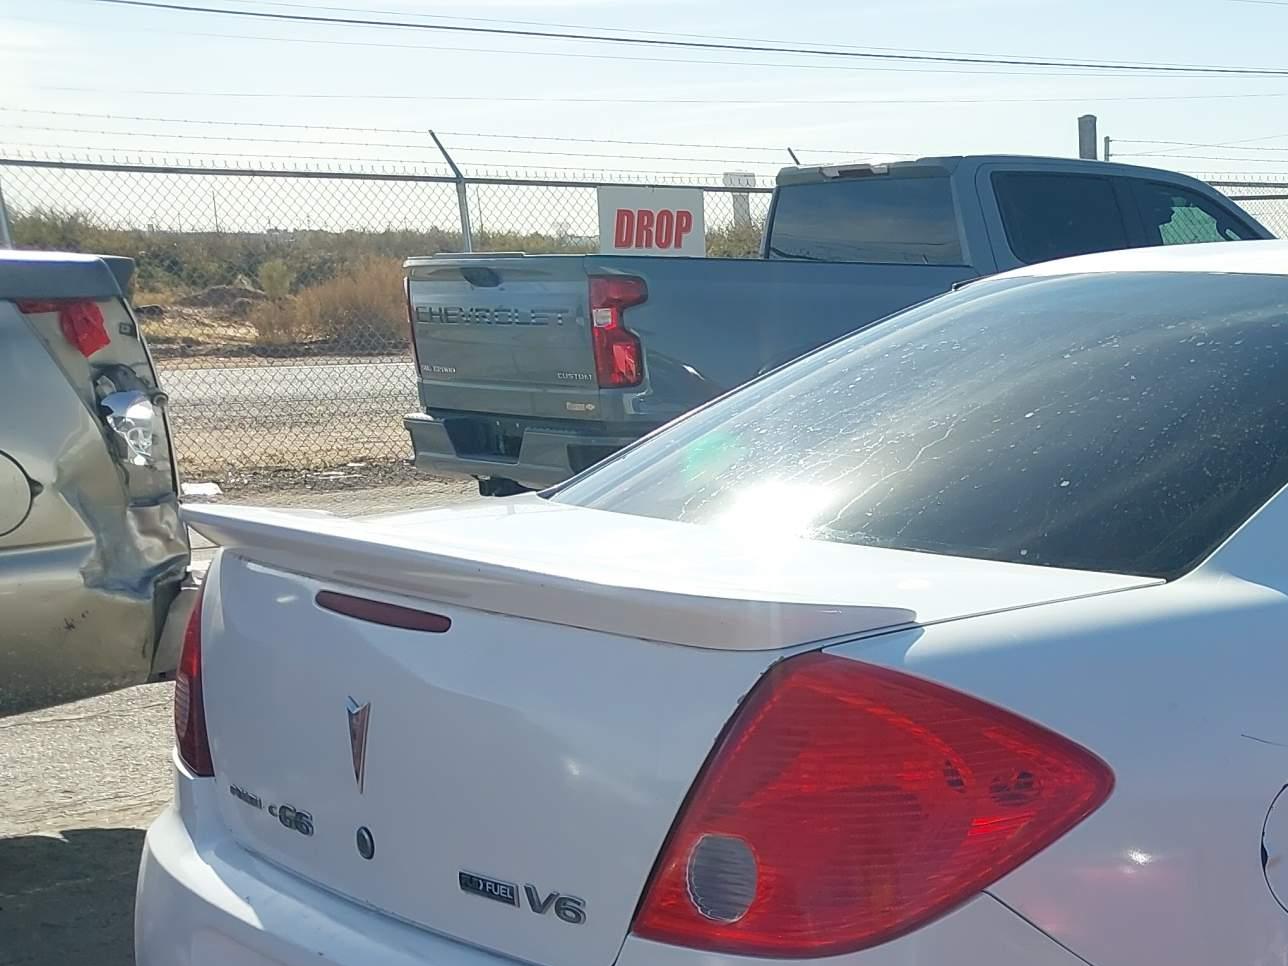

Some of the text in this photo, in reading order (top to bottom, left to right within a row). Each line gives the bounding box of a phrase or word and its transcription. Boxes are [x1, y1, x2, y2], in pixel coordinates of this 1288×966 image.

[614, 209, 692, 248] DROP
[415, 306, 569, 326] CHEVROLET
[279, 803, 314, 837] G6
[523, 883, 587, 925] V6
